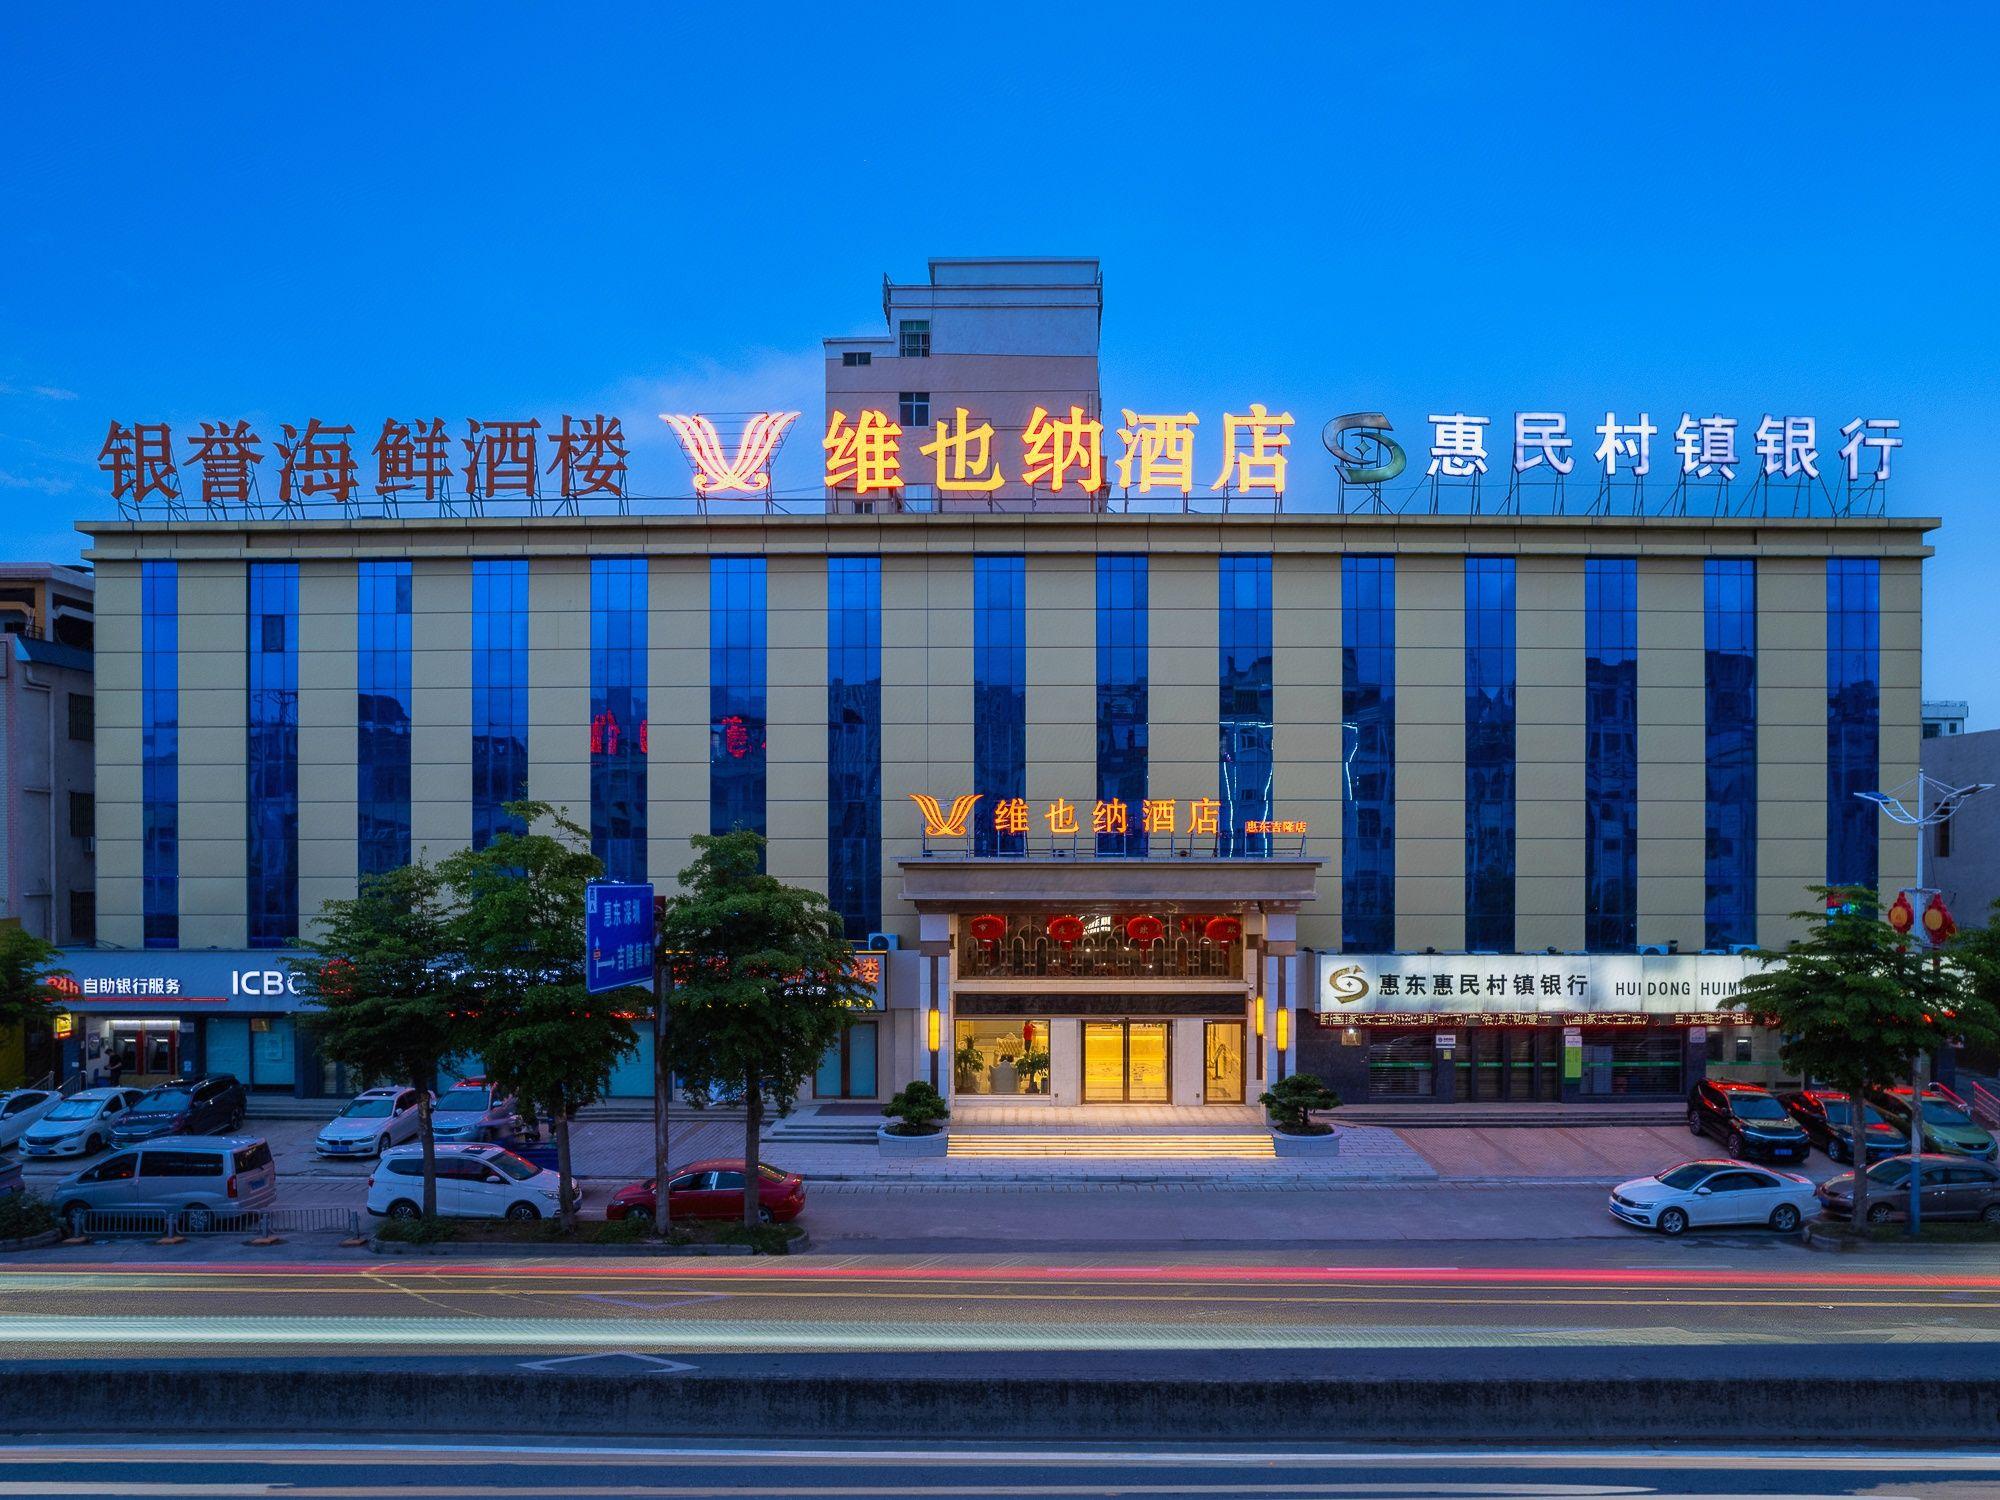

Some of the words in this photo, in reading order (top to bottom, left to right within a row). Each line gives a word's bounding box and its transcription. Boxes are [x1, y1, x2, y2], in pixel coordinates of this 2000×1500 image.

[98, 414, 630, 501] 银誉海鲜酒楼
[822, 403, 1297, 494] 维也纳酒店
[1426, 411, 1903, 481] 惠民村镇银行
[994, 797, 1222, 835] 维也纳酒店
[1246, 820, 1308, 833] 惠东吉隆店
[83, 977, 181, 995] 自助银行服务
[1379, 973, 1589, 996] 惠东惠民村镇银行
